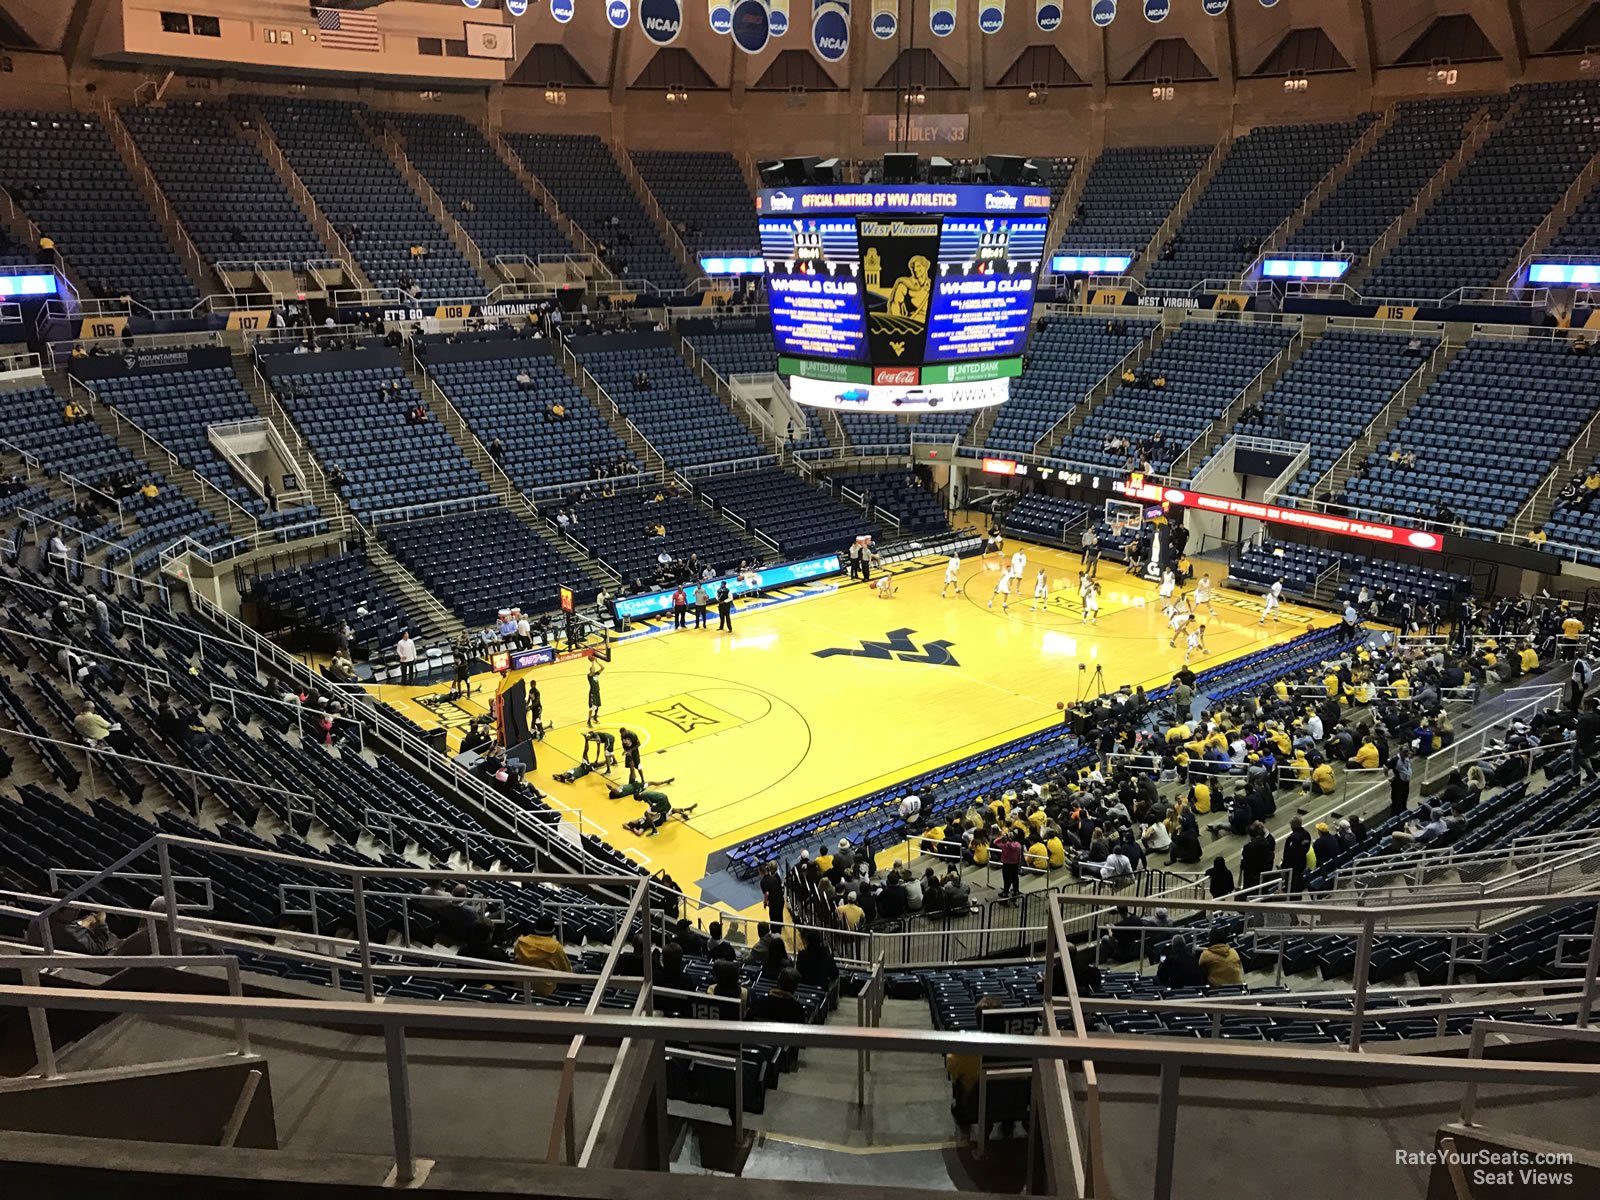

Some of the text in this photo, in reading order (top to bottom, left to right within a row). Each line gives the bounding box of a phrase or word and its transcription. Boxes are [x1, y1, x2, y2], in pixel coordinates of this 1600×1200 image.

[510, 1, 527, 9] NCAA
[1207, 1, 1227, 9] NCAA
[555, 8, 572, 17] NCAA
[611, 8, 627, 18] NIT
[1096, 12, 1114, 20] NCAA
[1148, 8, 1167, 16] NCAA
[647, 17, 679, 32] NCAA
[714, 20, 731, 28] NCAA
[770, 23, 787, 31] NCAA
[820, 37, 847, 49] NCAA
[952, 127, 965, 141] 33
[802, 194, 833, 207] OFFICIAL
[834, 193, 873, 206] PARTNER
[874, 193, 886, 206] OF
[887, 193, 909, 206] WVU
[910, 193, 957, 206] ATHLETICS
[861, 222, 890, 236] WEST
[891, 221, 938, 236] VIRGINIA
[770, 278, 858, 295] WHEELS CLUB
[940, 279, 1032, 295] WHEELS CLUB
[1103, 294, 1116, 305] 113
[1137, 296, 1199, 308] WEST VIRGINIA
[384, 308, 423, 321] ET'S GO
[445, 307, 463, 318] 108
[1387, 307, 1403, 319] 115
[239, 316, 259, 329] 107
[91, 324, 115, 337] 106
[807, 360, 848, 375] UNITED BANK
[954, 361, 999, 375] UNITED BANK
[691, 1002, 719, 1020] 126
[1004, 1018, 1035, 1035] 125
